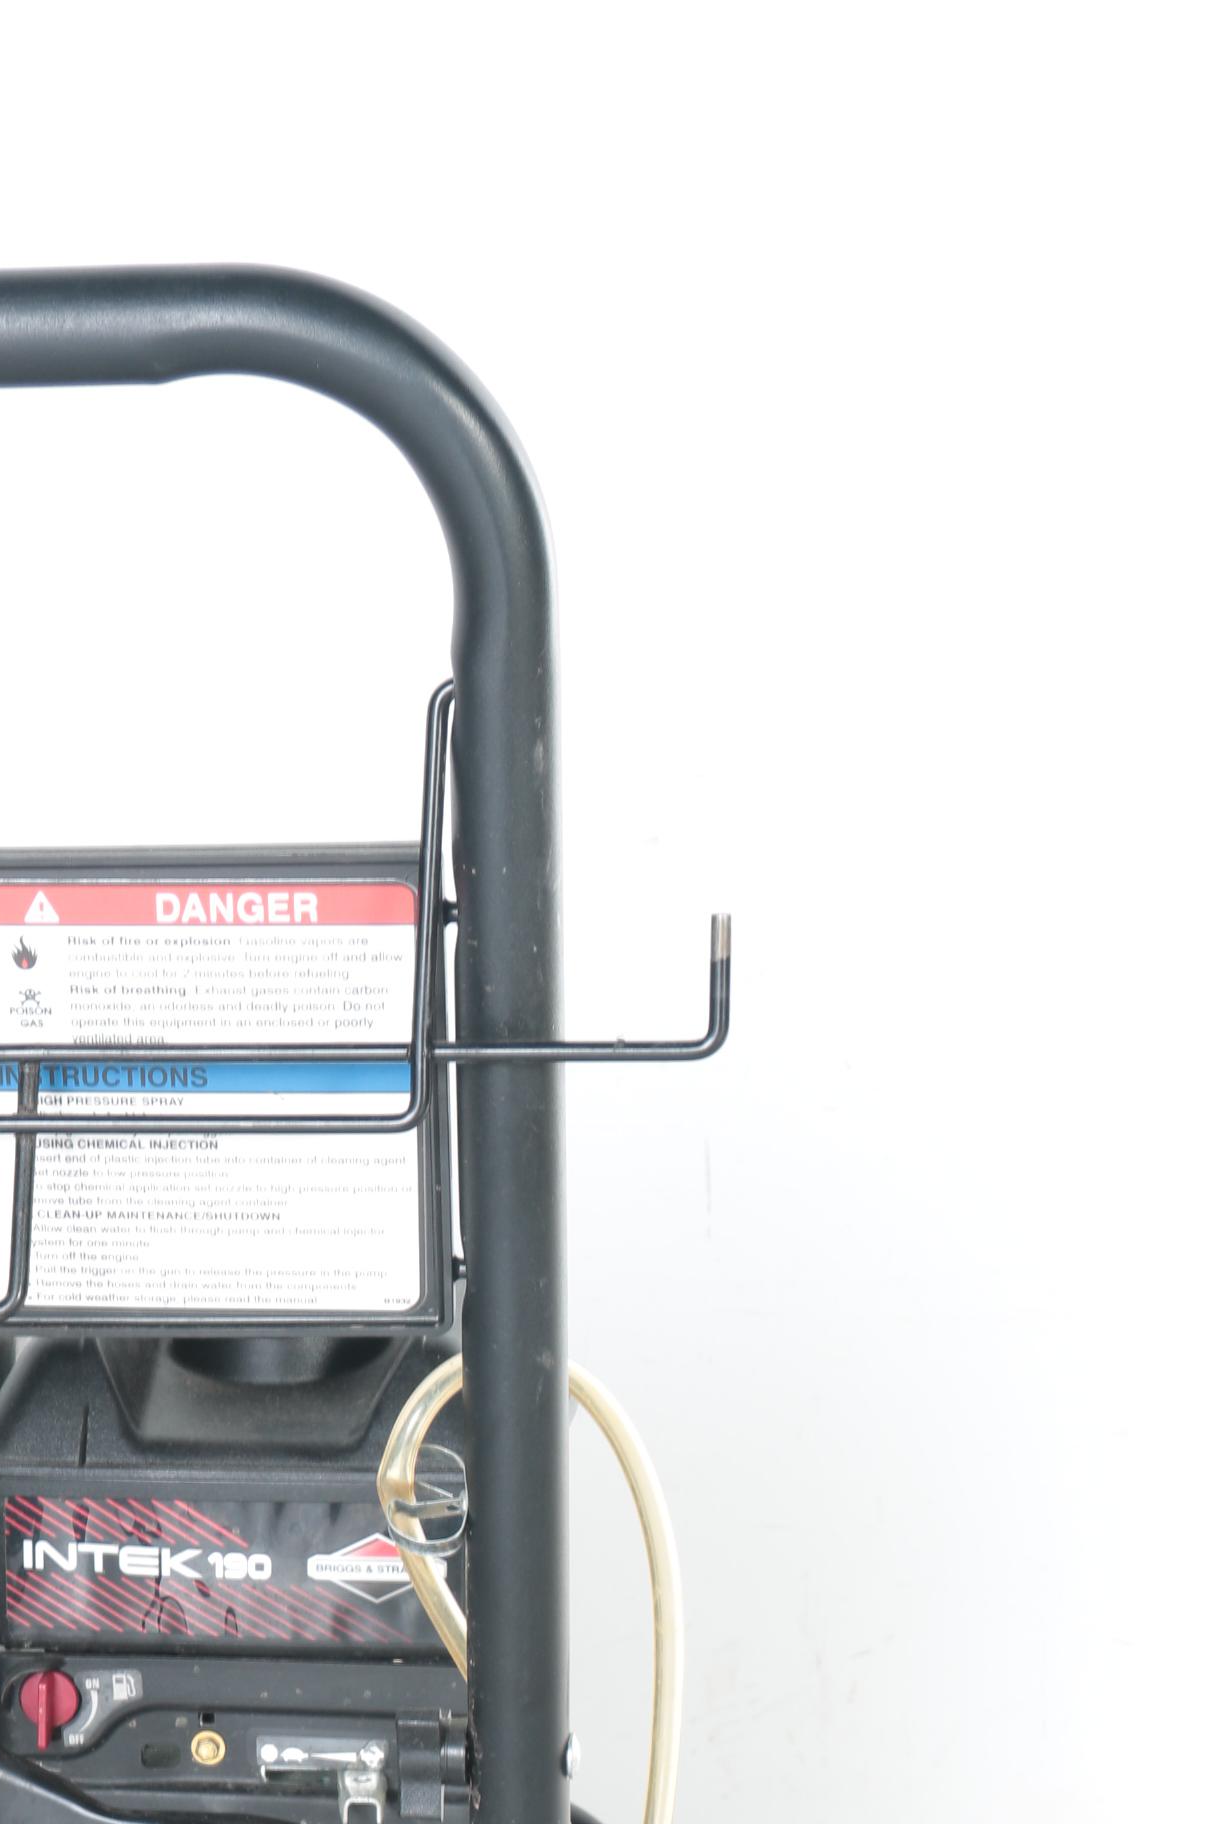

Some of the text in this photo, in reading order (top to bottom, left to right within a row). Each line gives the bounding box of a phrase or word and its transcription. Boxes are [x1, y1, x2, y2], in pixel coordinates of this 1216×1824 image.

[155, 892, 319, 923] DANGER
[67, 935, 97, 946] Risk
[101, 935, 114, 946] of
[119, 935, 141, 946] fire
[146, 937, 159, 946] or
[342, 952, 366, 962] and
[371, 952, 403, 962] allow
[70, 985, 98, 995] Risk
[104, 985, 116, 995] of
[344, 985, 388, 995] carbon
[10, 1006, 52, 1016] POISON
[219, 1002, 242, 1012] and
[246, 1001, 288, 1013] deadly
[343, 1001, 361, 1011] Do
[365, 1001, 384, 1011] not
[20, 1019, 44, 1028] GAS
[71, 1017, 118, 1030] operate
[123, 1018, 145, 1028] this
[220, 1018, 231, 1028] in
[236, 1019, 251, 1027] an
[318, 1019, 330, 1027] or
[335, 1017, 374, 1029] poorly
[40, 1096, 184, 1107] IGH PRESSURE SPRAY
[77, 1138, 145, 1150] CHEMICAL
[150, 1139, 219, 1150] INJECTION
[65, 1154, 86, 1163] end
[31, 1238, 65, 1248] ystem
[23, 1539, 273, 1581] INTEK 190
[315, 1562, 362, 1574] BRIGGS
[366, 1564, 373, 1574] &
[85, 1677, 100, 1690] ON
[68, 1733, 84, 1745] OFF
